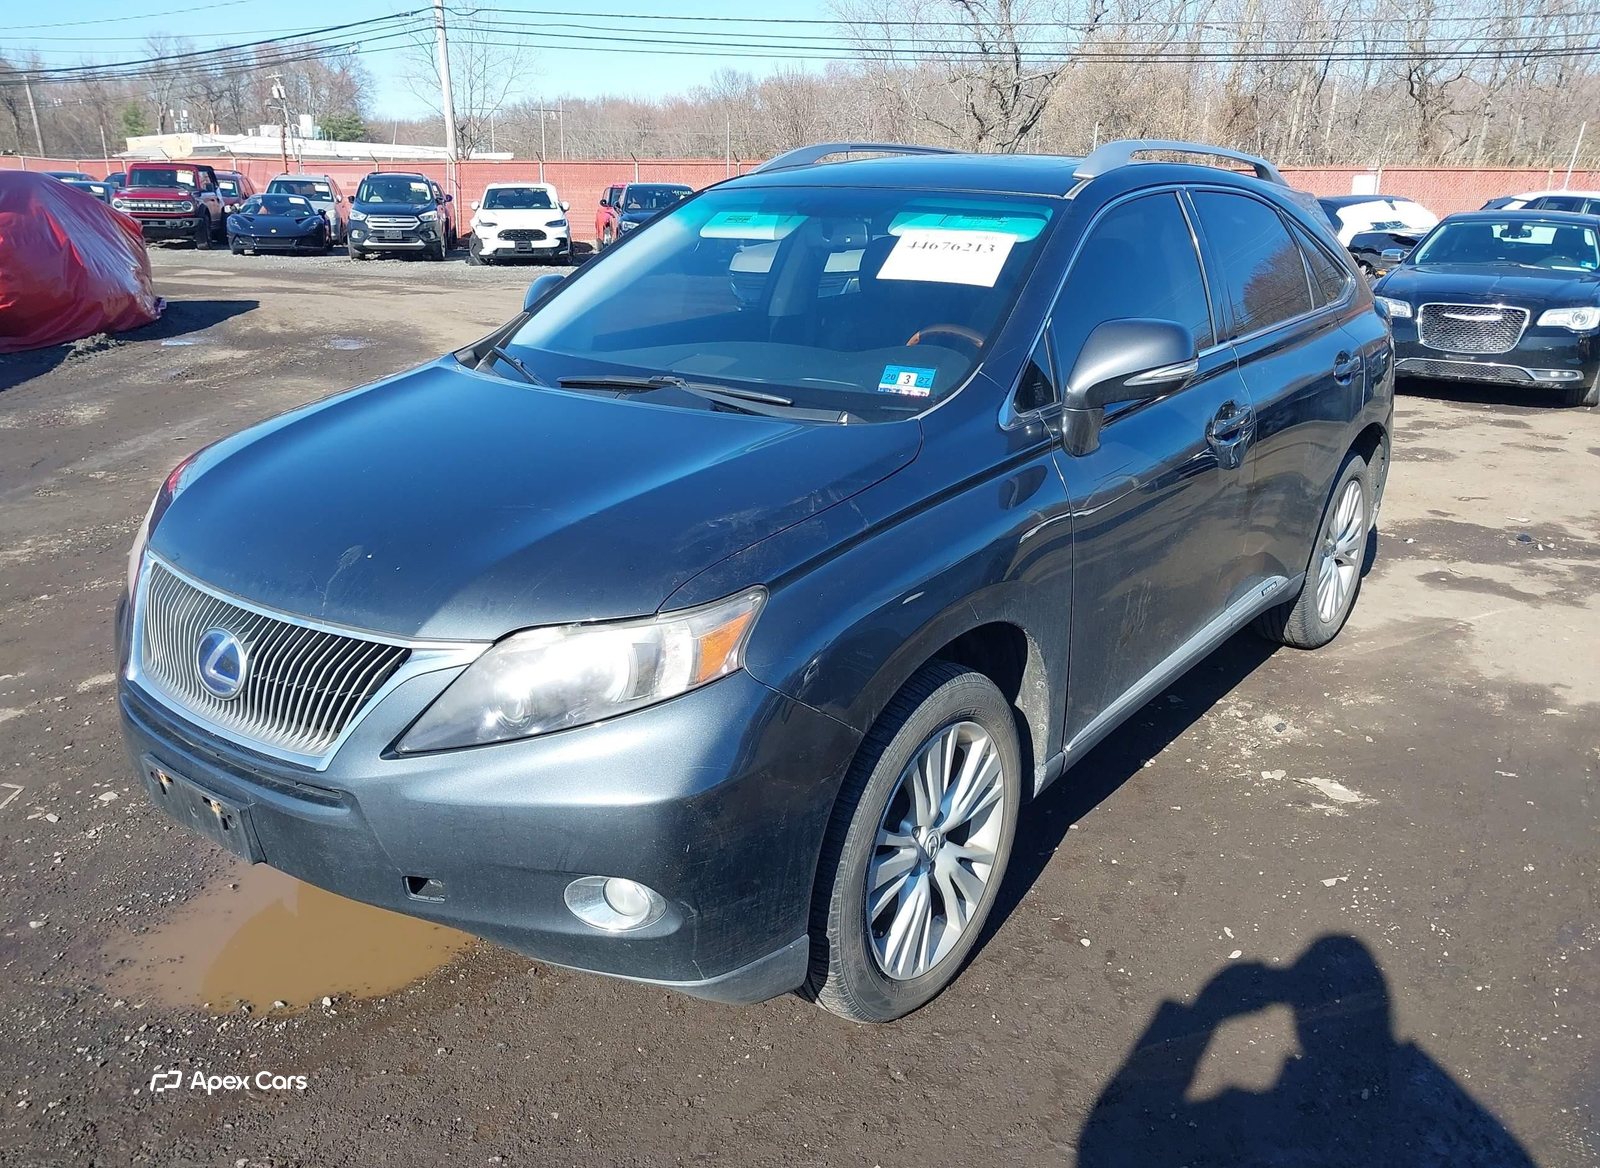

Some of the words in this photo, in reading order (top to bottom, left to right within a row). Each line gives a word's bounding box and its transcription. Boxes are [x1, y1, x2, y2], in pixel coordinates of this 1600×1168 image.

[906, 240, 996, 254] 44676213
[885, 373, 897, 381] 20
[903, 374, 912, 385] 3
[918, 377, 931, 385] 27
